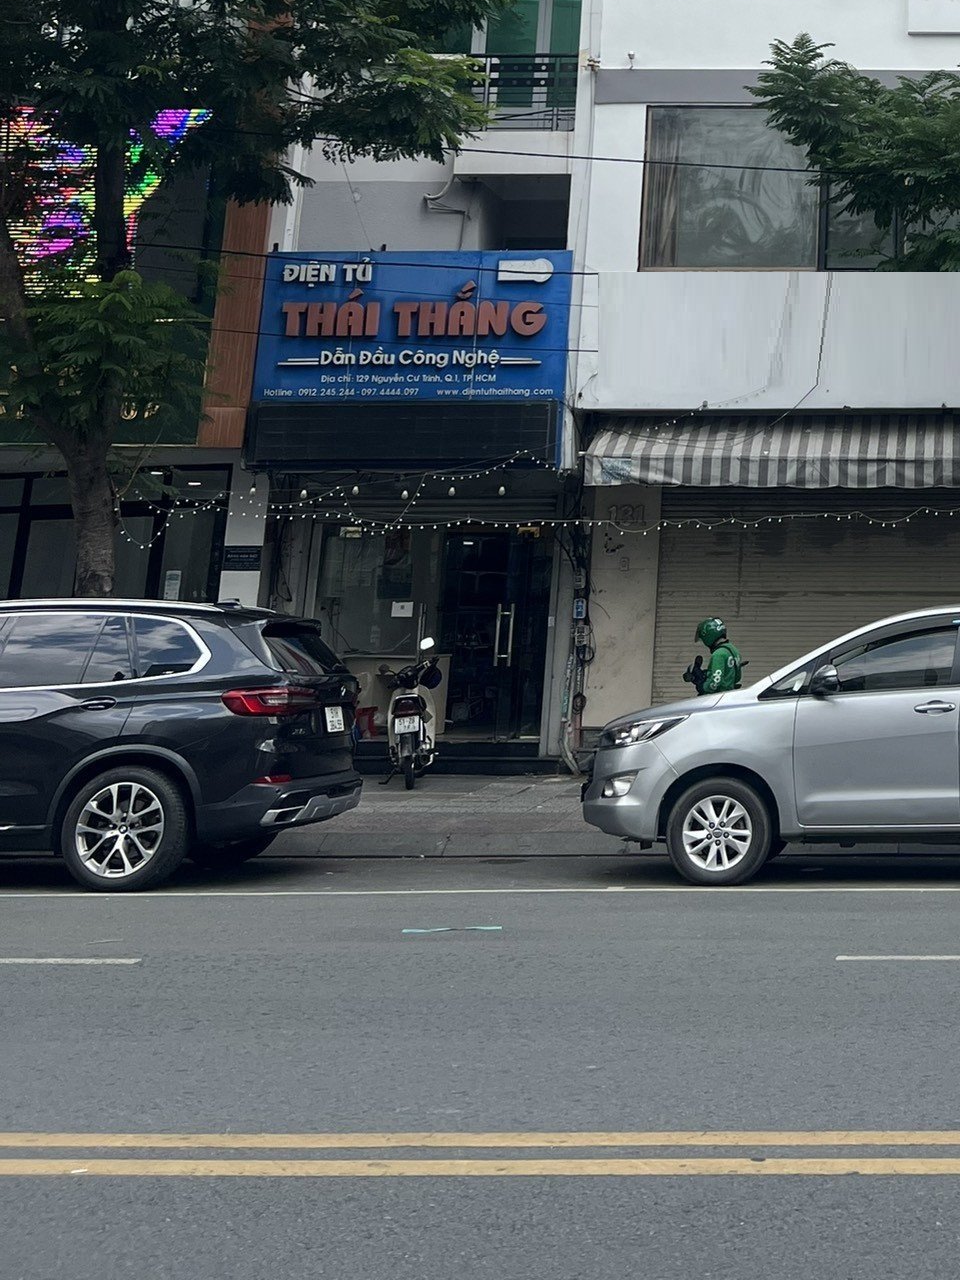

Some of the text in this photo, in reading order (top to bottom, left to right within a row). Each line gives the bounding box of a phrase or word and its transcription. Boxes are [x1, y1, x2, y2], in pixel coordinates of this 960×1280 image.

[283, 257, 376, 287] ĐIỆN TỬ
[282, 280, 548, 337] THÁI THẮNG
[320, 346, 500, 369] Dẫn Đầu Công Nghệ
[321, 374, 336, 384] Địa
[356, 374, 369, 383] 129
[608, 505, 646, 526] 131
